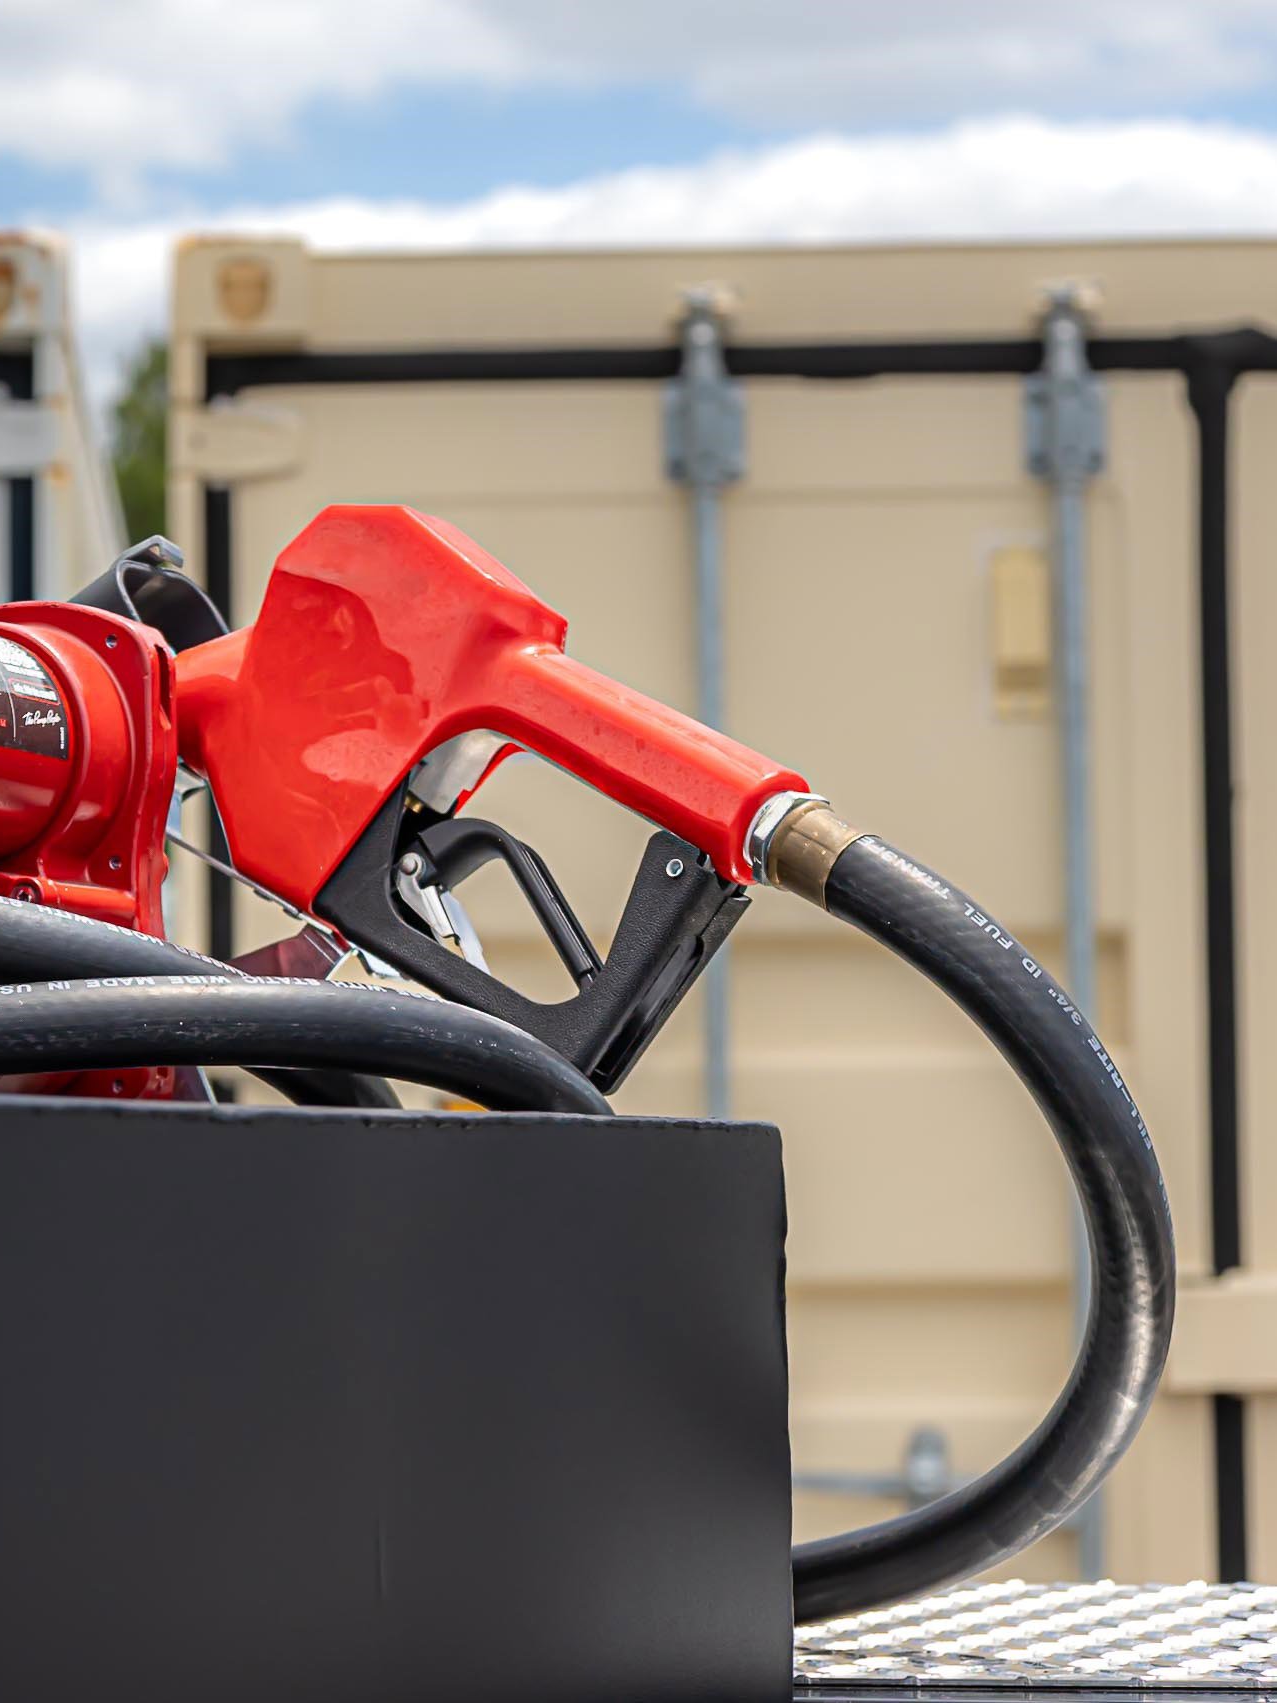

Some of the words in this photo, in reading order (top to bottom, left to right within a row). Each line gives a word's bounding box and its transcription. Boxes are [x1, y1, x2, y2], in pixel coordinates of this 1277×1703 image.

[963, 902, 1014, 950] FUEL
[1021, 956, 1043, 979] ID
[48, 980, 71, 991] IN
[86, 976, 156, 989] MADE
[168, 975, 228, 985] WIRE
[1047, 988, 1082, 1025] 3/4"
[1087, 1035, 1152, 1151] FILL-RITE
